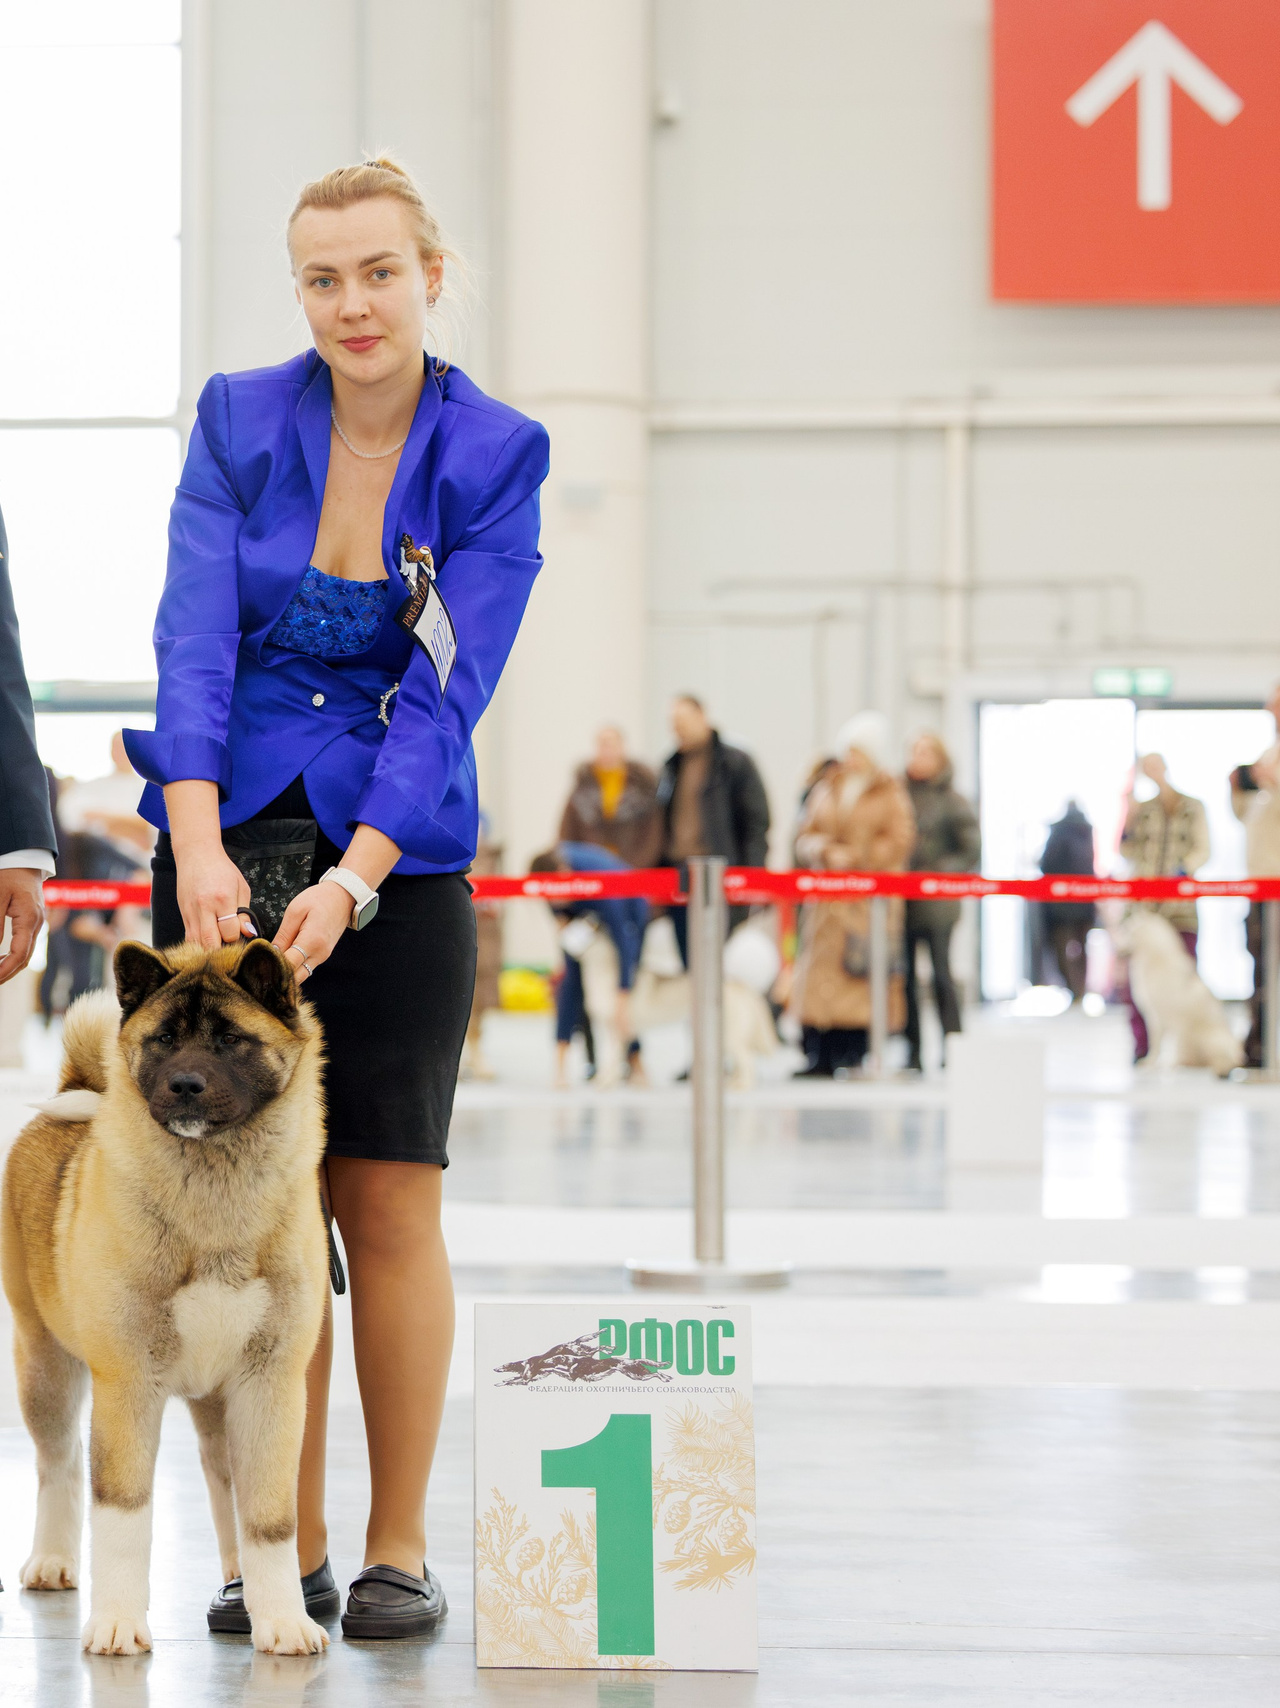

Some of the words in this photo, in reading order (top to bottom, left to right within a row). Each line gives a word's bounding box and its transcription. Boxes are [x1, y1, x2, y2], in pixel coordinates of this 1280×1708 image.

[598, 1318, 736, 1376] РФОС
[527, 1385, 584, 1393] ФЕДЕРАЦИЯ
[585, 1385, 654, 1393] ОХОТНИЧЬЕГО
[656, 1385, 736, 1394] СОБАКОВОДСТВА
[541, 1413, 655, 1655] 1
